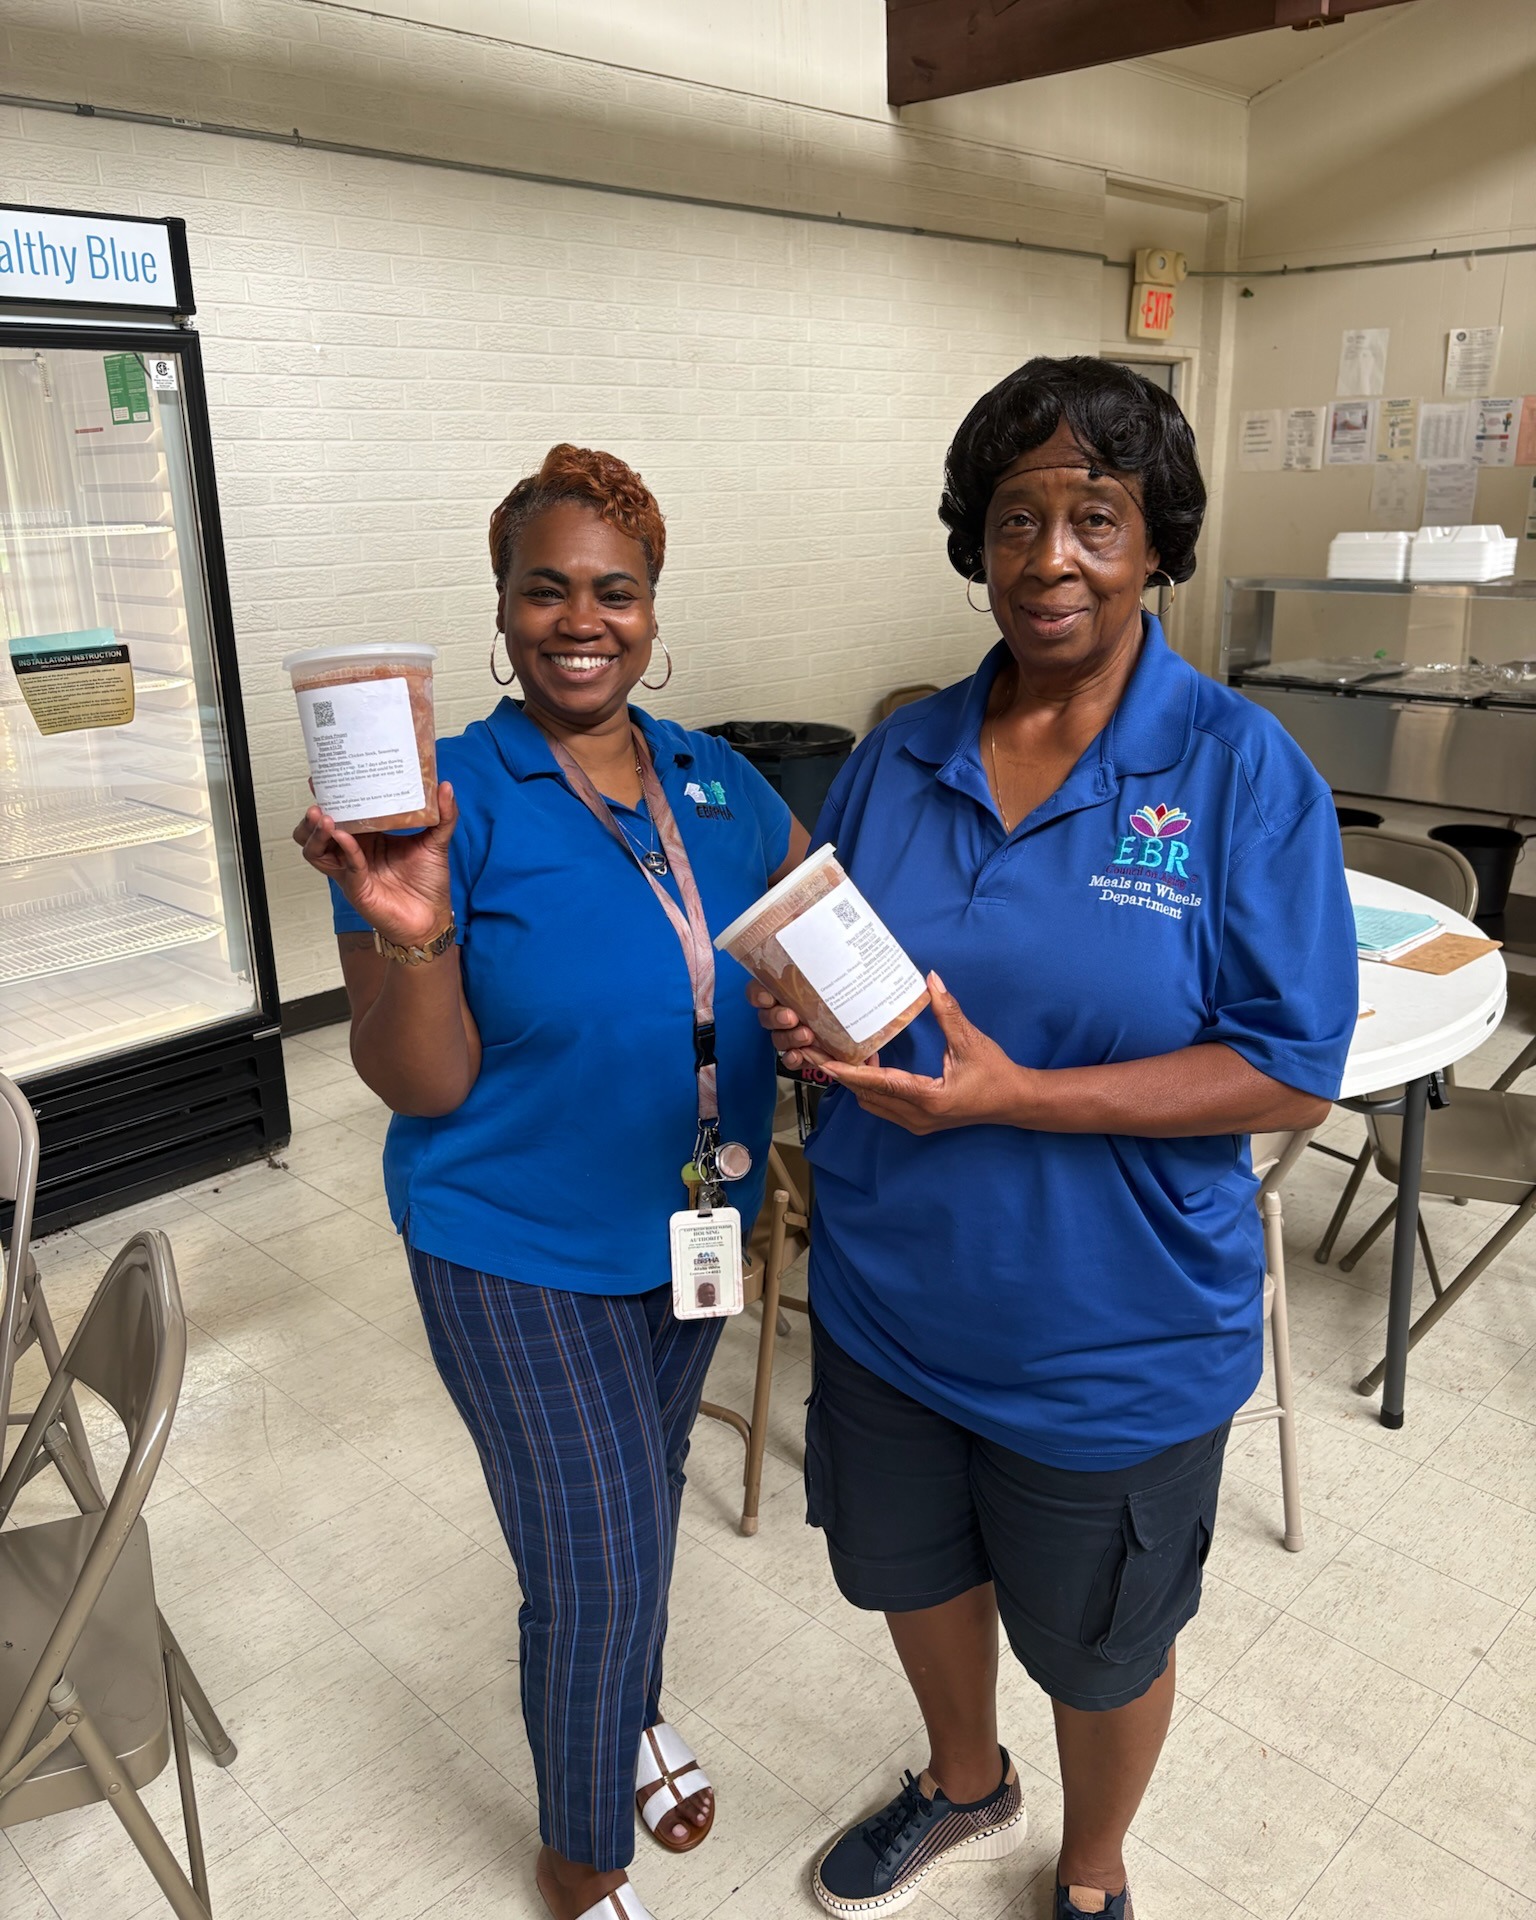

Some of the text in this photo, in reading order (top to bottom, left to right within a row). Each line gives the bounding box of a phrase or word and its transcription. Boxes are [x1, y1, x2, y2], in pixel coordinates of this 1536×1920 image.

[86, 235, 157, 283] Blue
[1145, 290, 1173, 330] EXIT
[18, 655, 71, 667] INSTALLATION
[72, 650, 122, 661] INSTRUCTION
[1112, 836, 1190, 878] EBR
[1089, 876, 1202, 907] Meals on Wheels
[1099, 890, 1183, 919] Department
